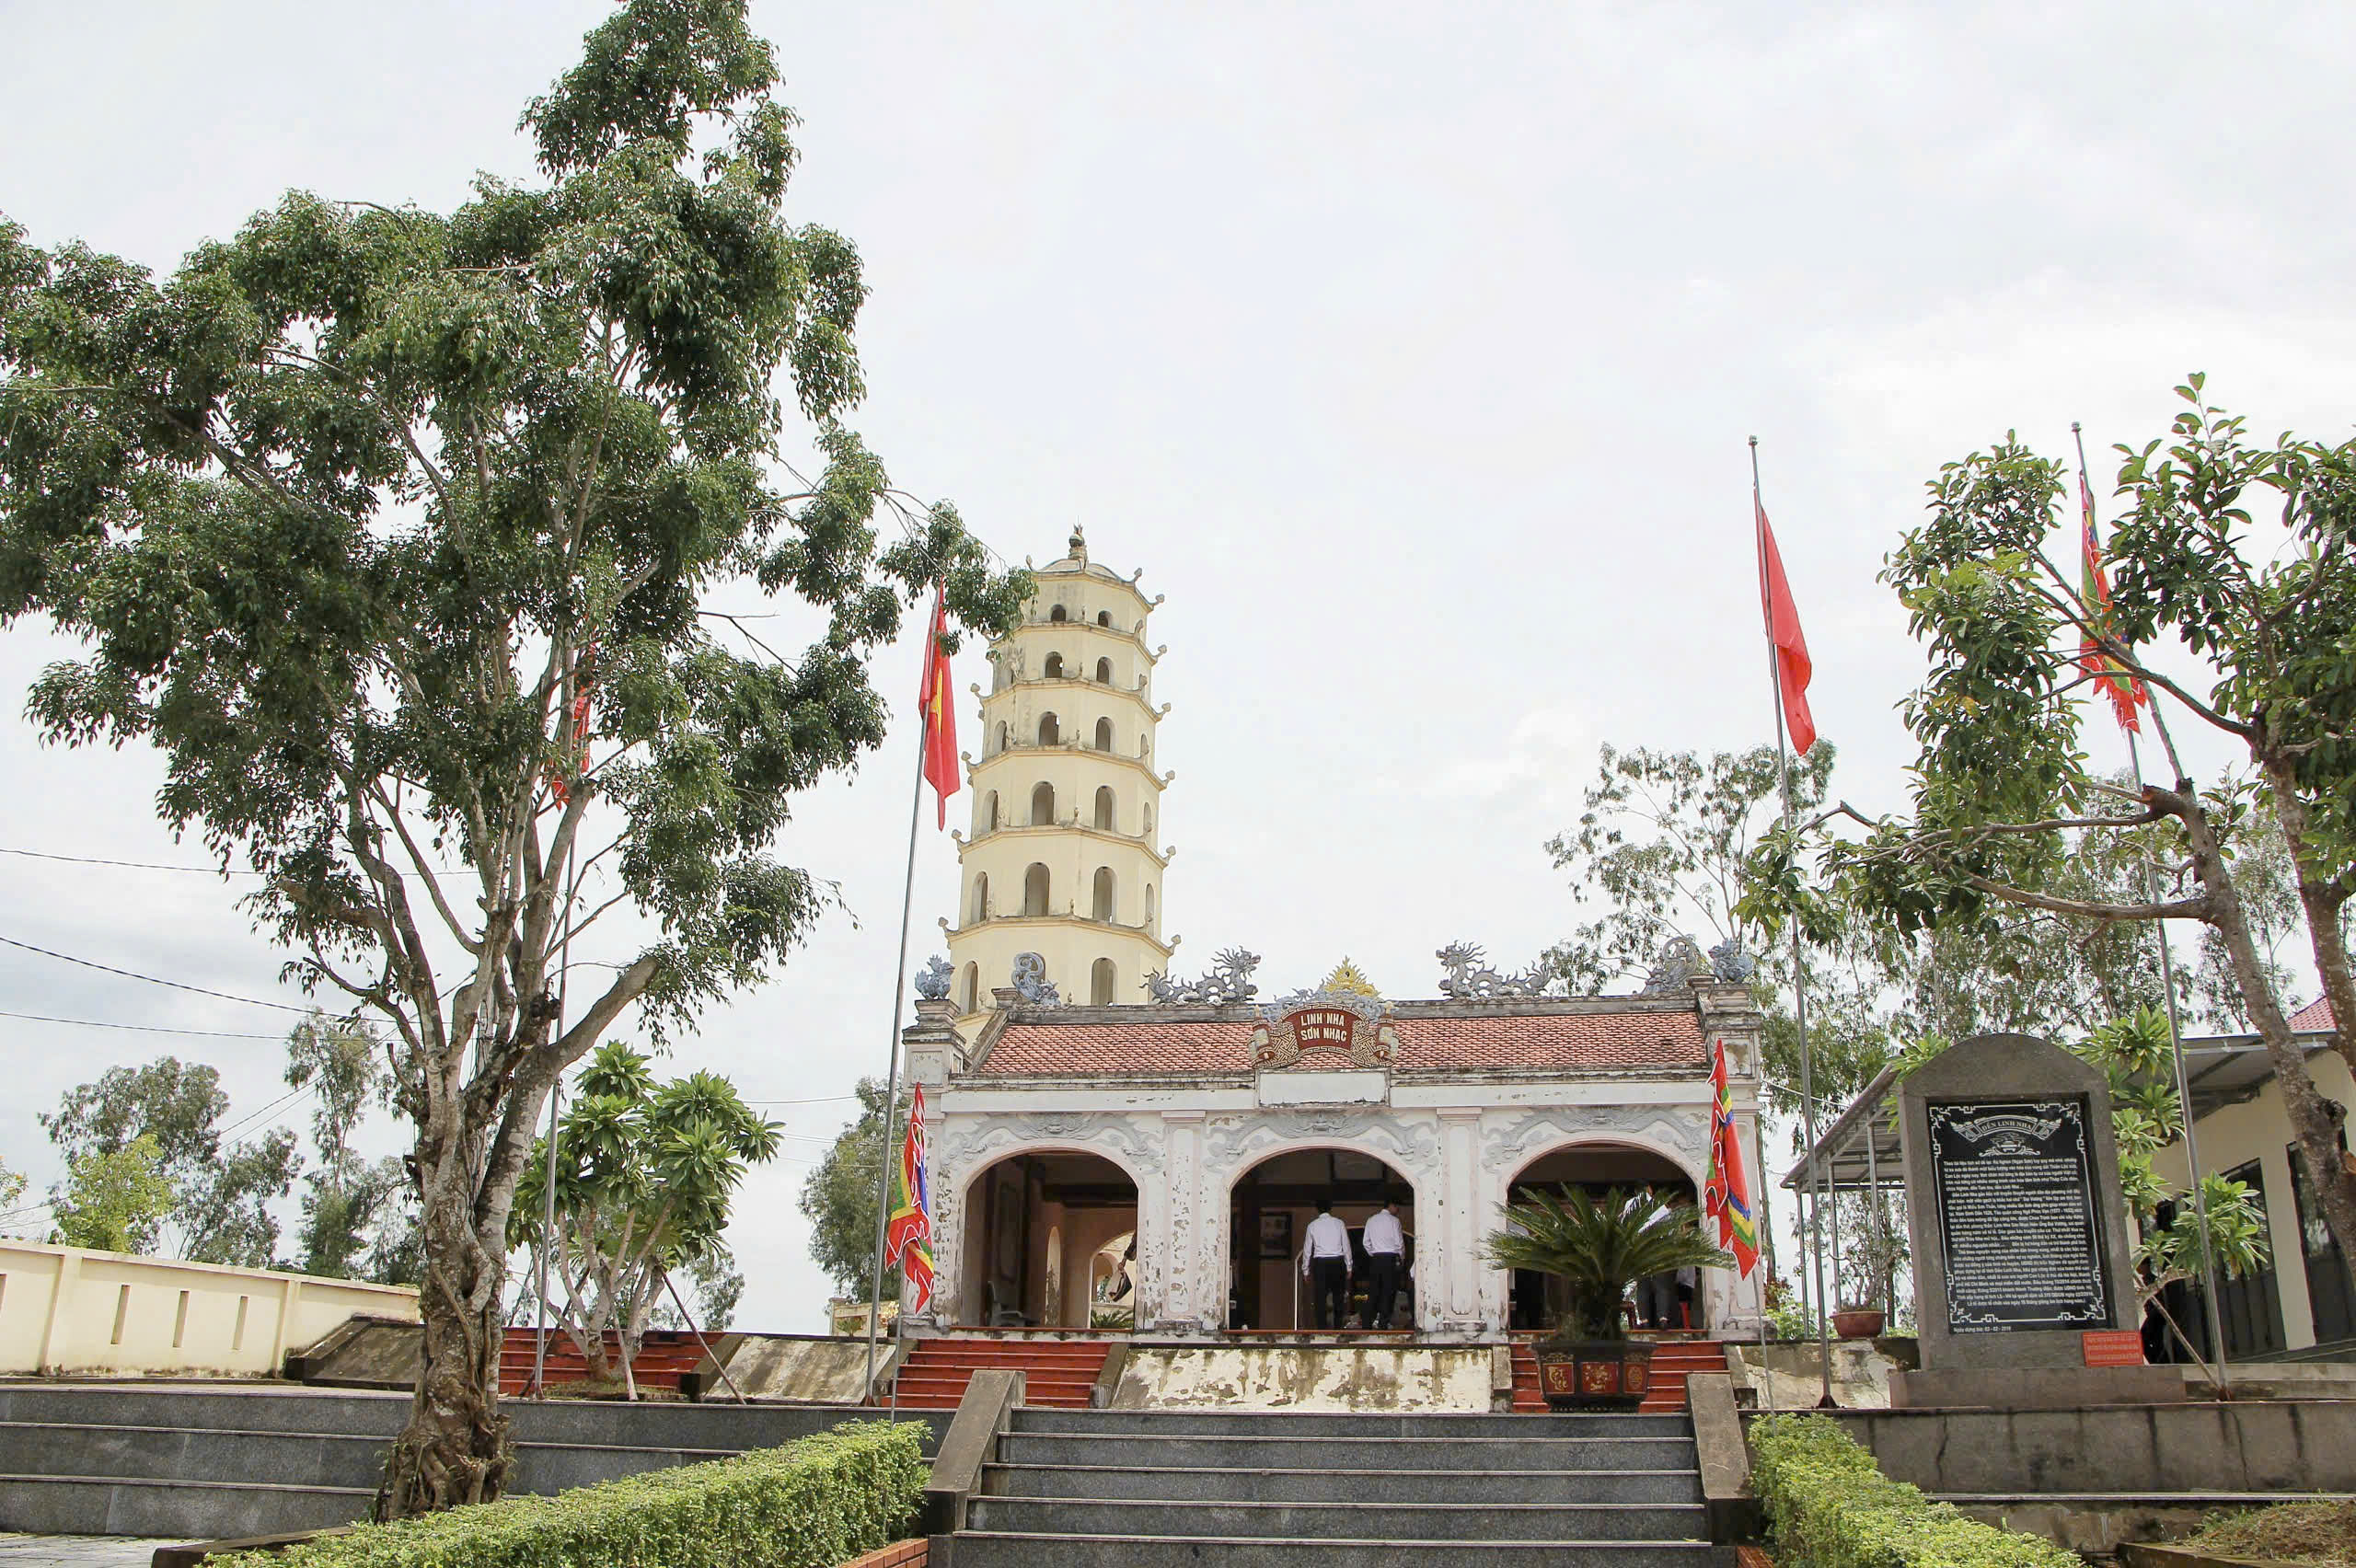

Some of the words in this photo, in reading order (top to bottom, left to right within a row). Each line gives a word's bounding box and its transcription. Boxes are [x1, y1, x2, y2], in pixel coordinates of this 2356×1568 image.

[1300, 1012, 1322, 1026] LINH
[1326, 1012, 1345, 1027] NHA
[1300, 1026, 1321, 1041] SƠN
[1323, 1027, 1347, 1043] NHẠC
